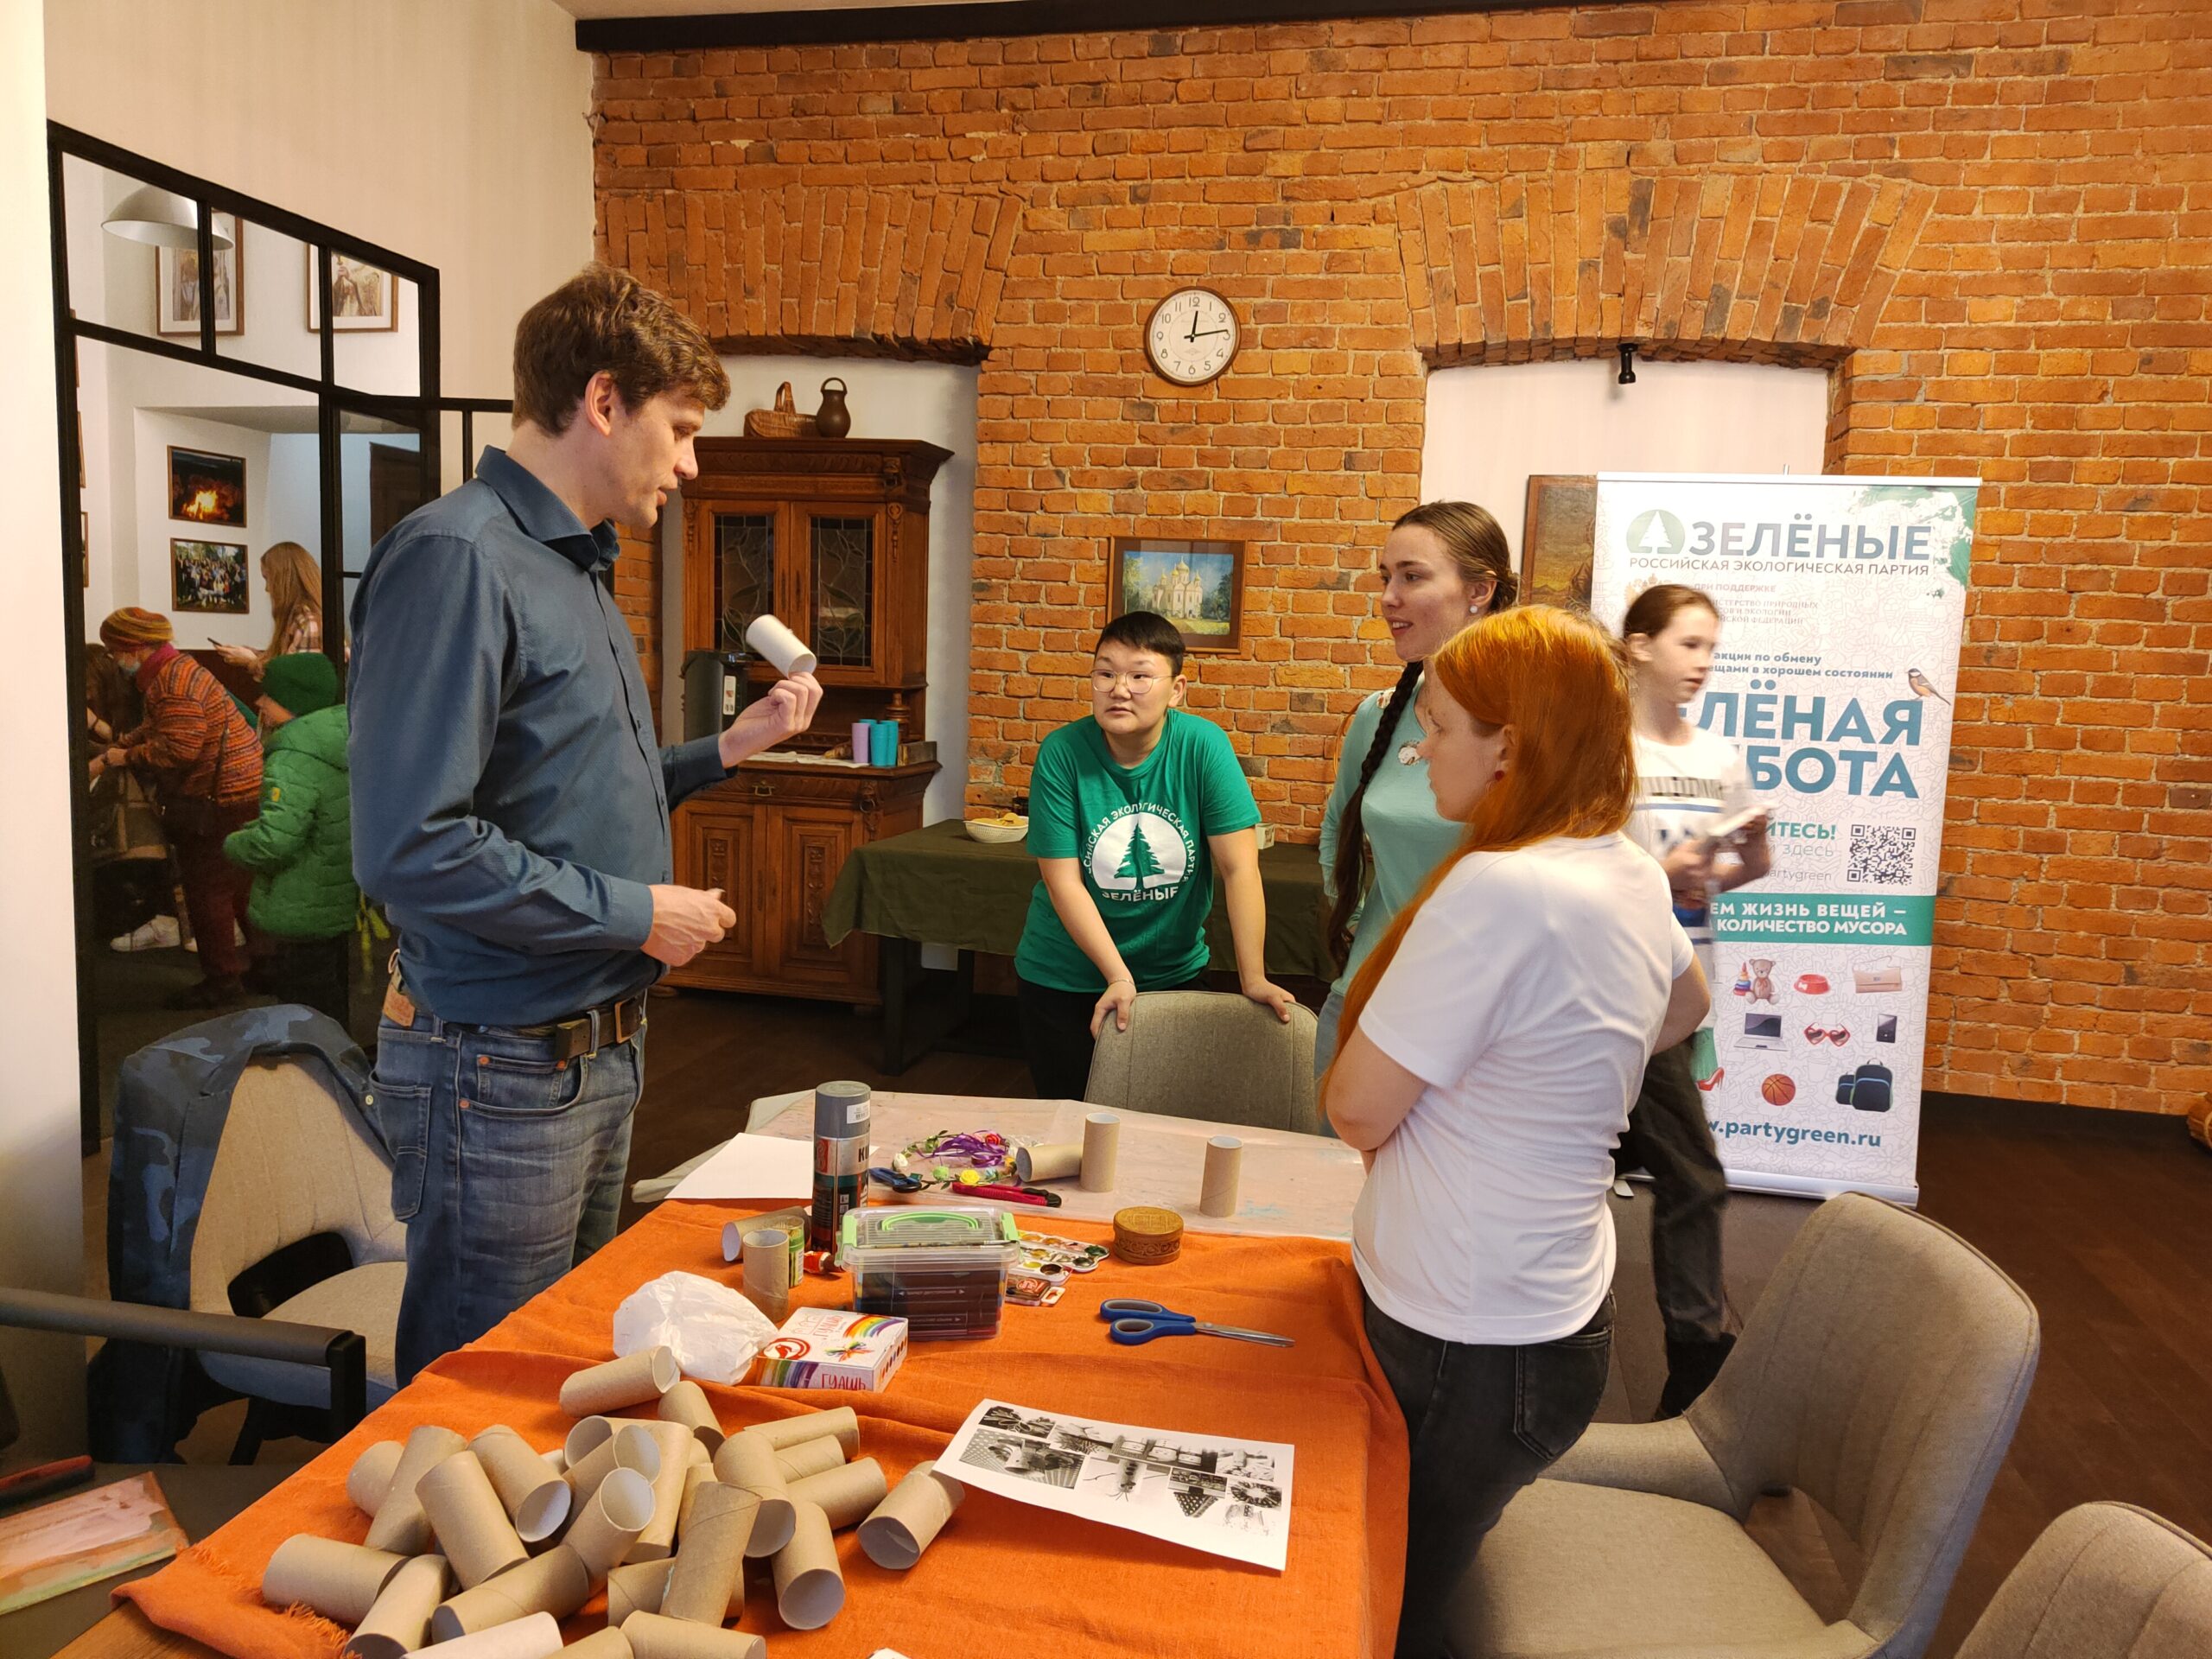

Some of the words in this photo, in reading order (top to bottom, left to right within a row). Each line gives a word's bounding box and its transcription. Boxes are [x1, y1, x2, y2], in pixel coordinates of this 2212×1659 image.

[1175, 302, 1182, 311] 11
[1189, 297, 1200, 307] 12
[1162, 315, 1172, 323] 10
[1218, 313, 1226, 322] 2
[1157, 332, 1164, 340] 9
[1223, 329, 1230, 340] 3
[1160, 349, 1168, 359] 8
[1217, 349, 1224, 358] 4
[1174, 361, 1181, 372] 7
[1188, 365, 1196, 374] 6
[1204, 361, 1211, 371] 5
[1688, 513, 1932, 562] ЗЕЛЁНЫЕ
[1629, 556, 1730, 571] РОССИЙСКАЯ
[1733, 558, 1865, 575] ЭКОЛОГИЧЕСКАЯ
[1867, 562, 1929, 576] ПАРТИЯ
[1715, 582, 1777, 594] ПОДДЕРЖКЕ
[1713, 652, 1751, 662] акции
[1754, 652, 1770, 662] по
[1773, 652, 1822, 666] обмену
[1707, 664, 1749, 674] ещами
[1762, 665, 1822, 677] хорошем
[1824, 666, 1894, 680] состоянии
[1694, 679, 1924, 747] ЛЁНАЯ
[1745, 744, 1920, 799] БОТА
[1783, 843, 1834, 858] здесь
[1766, 868, 1833, 883] artygreen
[1741, 902, 1810, 917] ЖИЗНЬ
[1816, 901, 1886, 919] ВЕЩЕЙ
[1716, 918, 1830, 934] КОЛИЧЕСТВО
[1833, 920, 1908, 936] МУСОРА
[821, 1373, 868, 1391] ГУАШЬ
